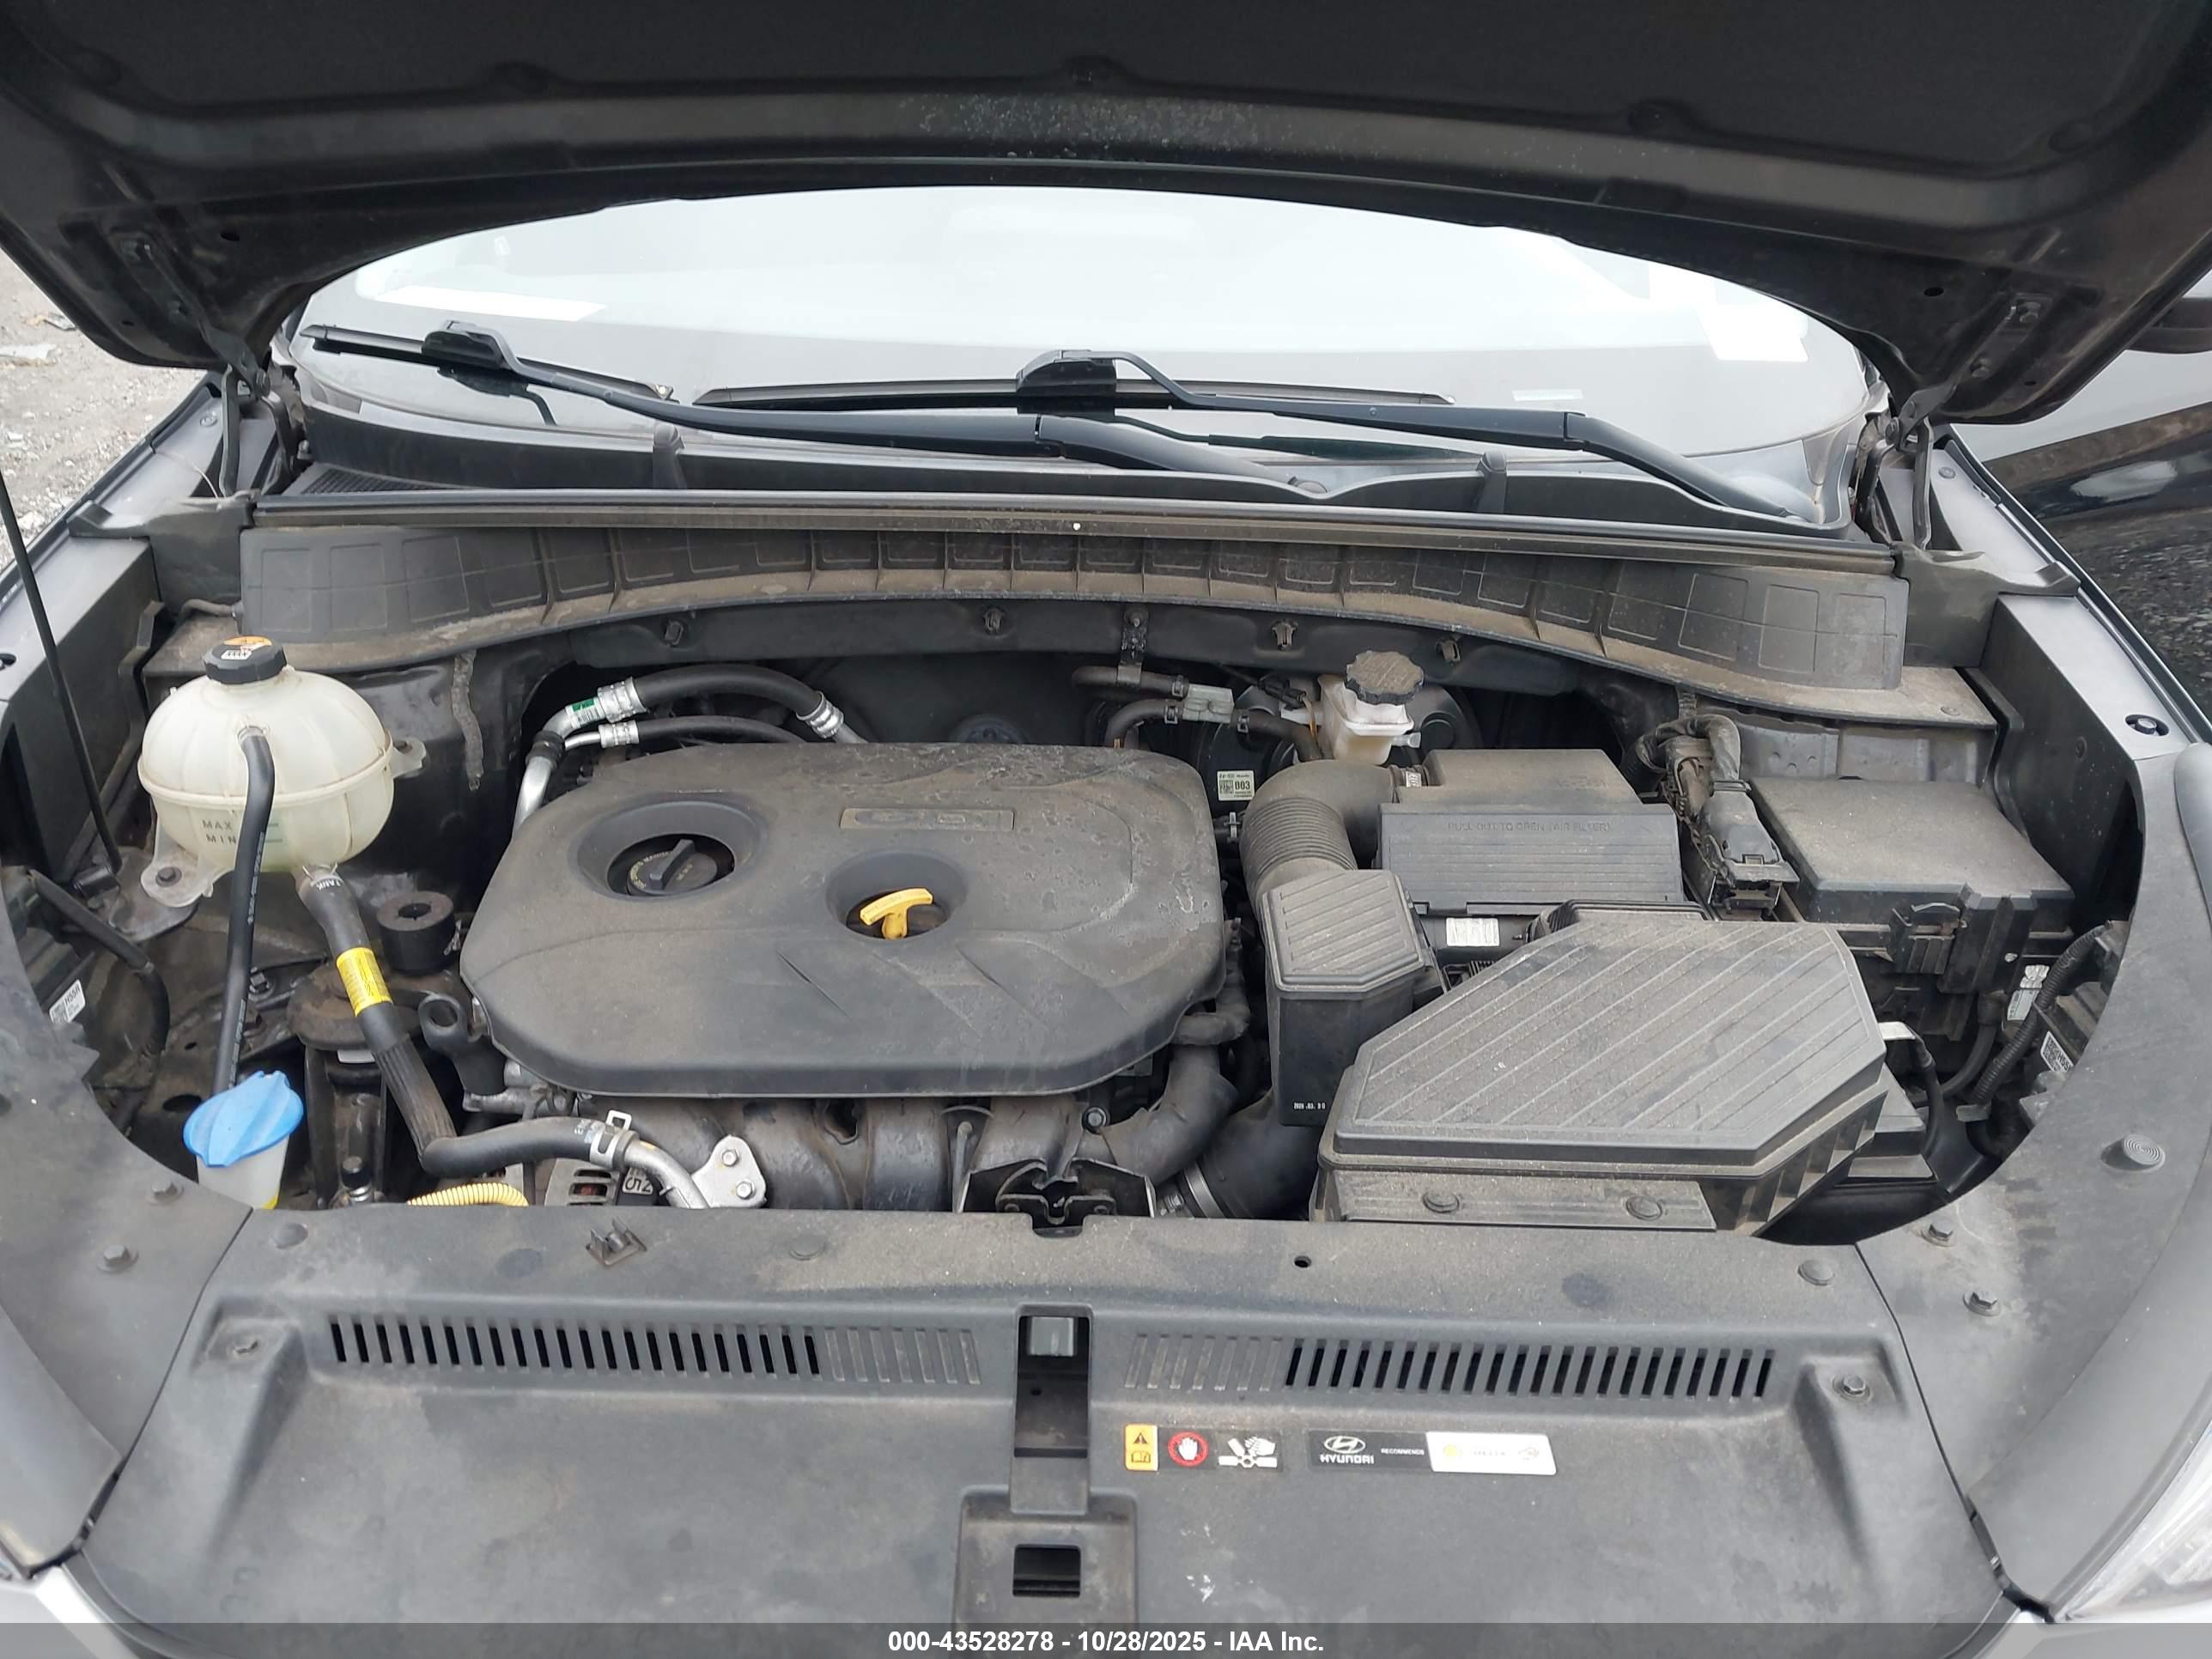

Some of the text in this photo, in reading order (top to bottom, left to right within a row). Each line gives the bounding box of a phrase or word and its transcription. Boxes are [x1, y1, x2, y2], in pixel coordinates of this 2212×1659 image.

[202, 818, 233, 831] MAX
[1447, 822, 1473, 831] PULL
[1476, 822, 1498, 831] OUT
[1501, 822, 1514, 832] TO
[1516, 822, 1545, 832] OPEN
[205, 834, 237, 845] MIN
[1320, 1454, 1374, 1464] HYUNDAI
